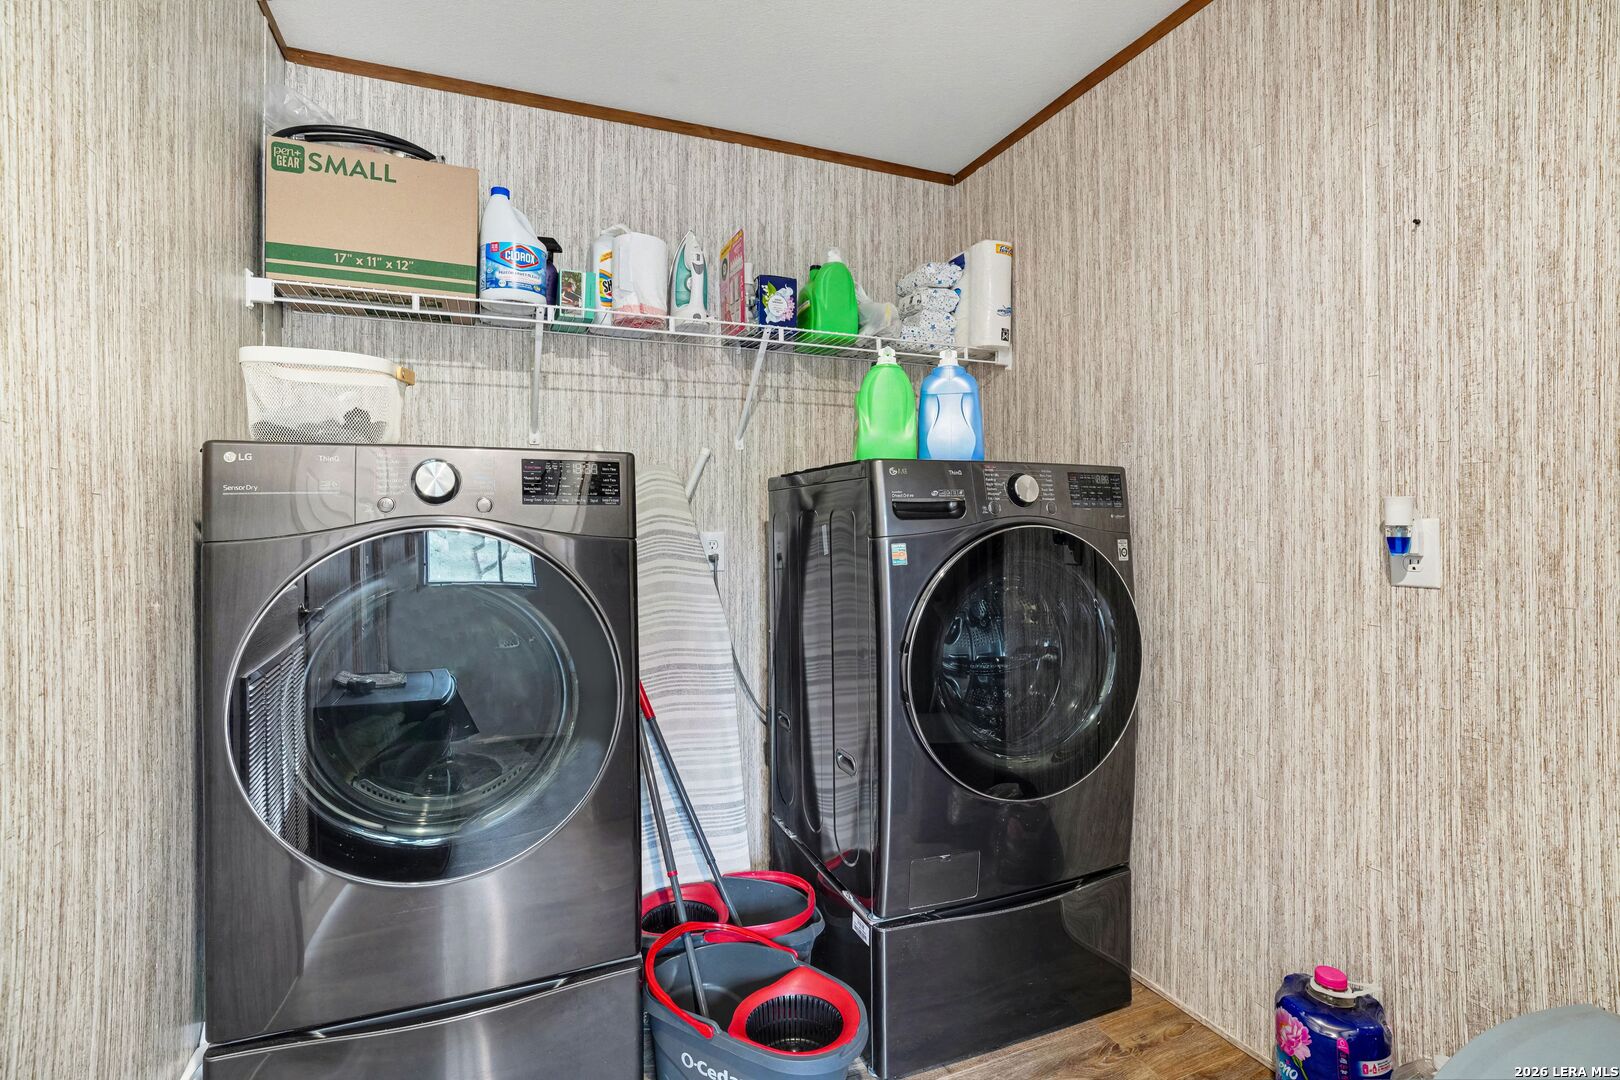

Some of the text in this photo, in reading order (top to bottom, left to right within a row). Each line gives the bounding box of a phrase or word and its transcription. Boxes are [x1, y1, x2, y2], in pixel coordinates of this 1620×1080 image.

[276, 154, 300, 169] GEAR
[308, 152, 397, 184] SMALL
[333, 252, 414, 271] 17" x 11" x 12"
[505, 250, 536, 265] CLOROX
[602, 279, 612, 292] SH
[238, 452, 253, 461] LG
[681, 1052, 740, 1080] O-Ced
